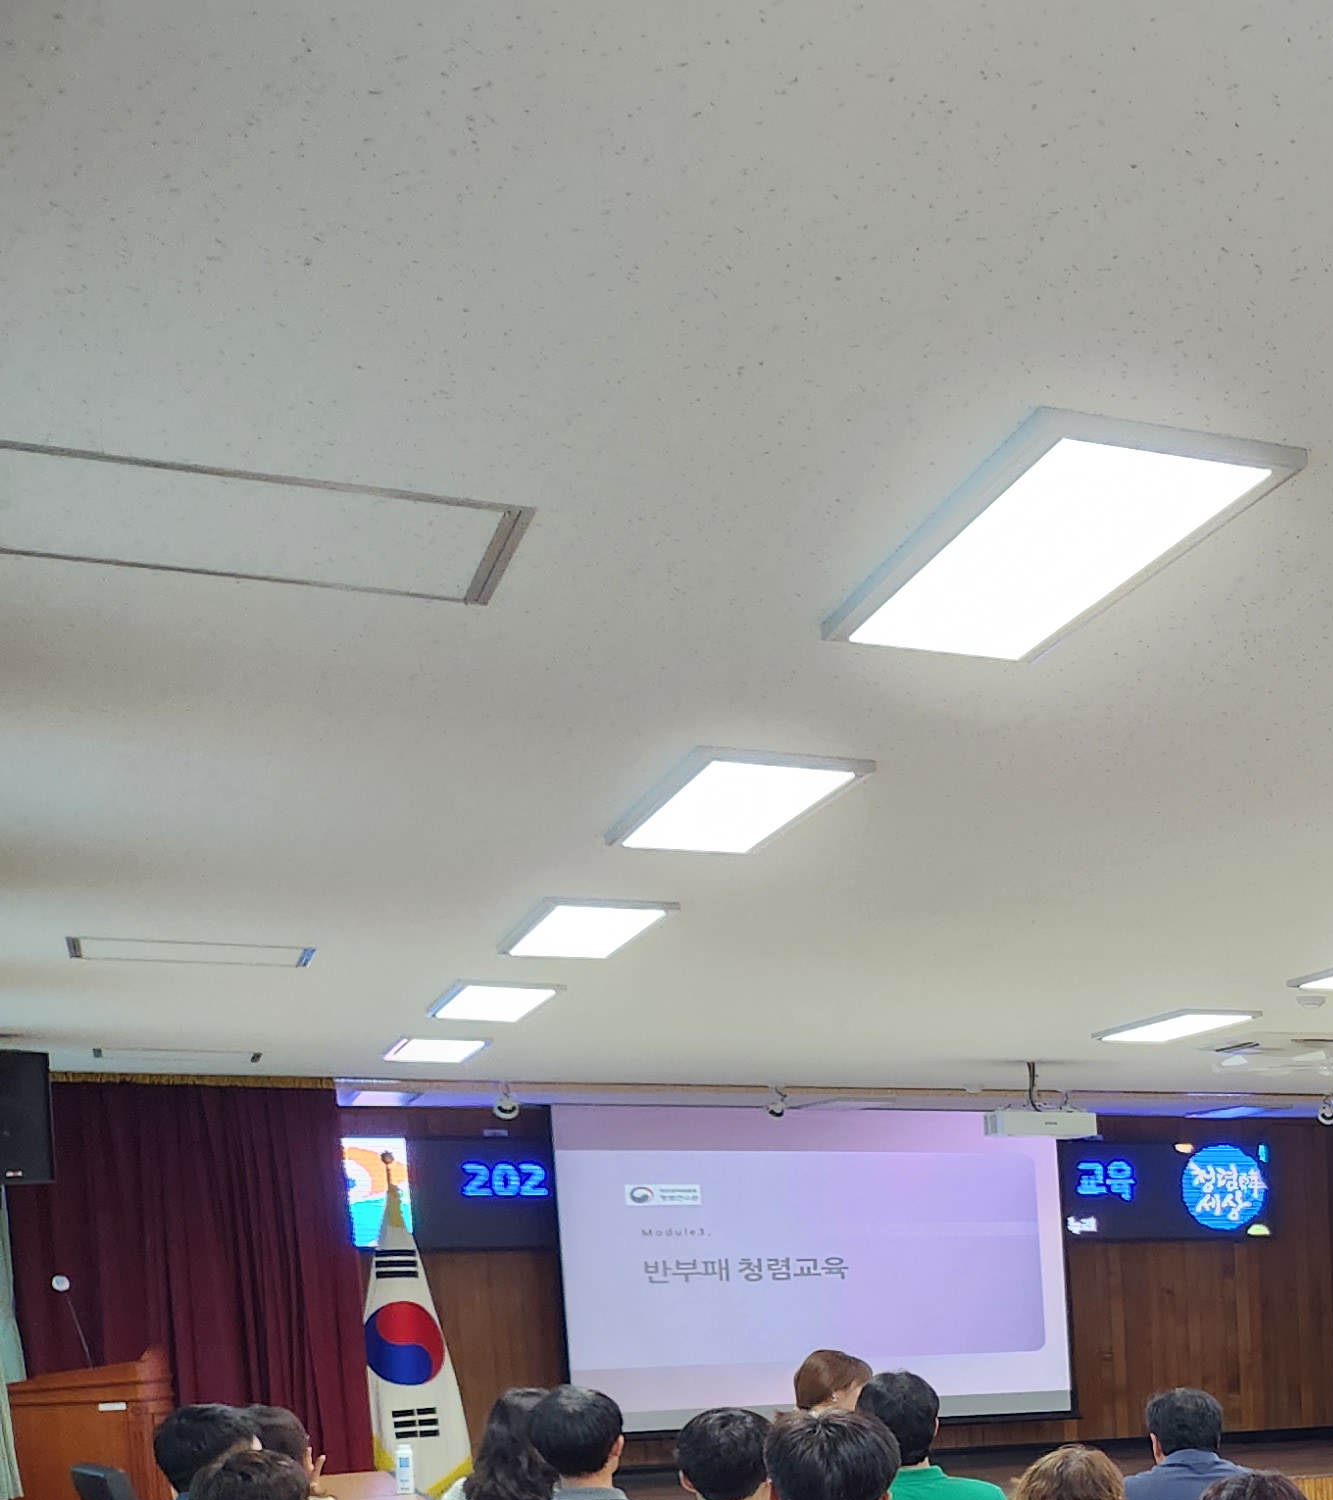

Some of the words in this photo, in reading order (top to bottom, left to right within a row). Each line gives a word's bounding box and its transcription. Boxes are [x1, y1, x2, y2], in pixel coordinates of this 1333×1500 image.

[462, 1163, 548, 1197] 202
[1076, 1160, 1135, 1201] 교육
[1196, 1191, 1252, 1221] 세상
[641, 1228, 712, 1237] Module3.
[644, 1258, 730, 1284] 반부패
[738, 1257, 849, 1282] 청렴교육
